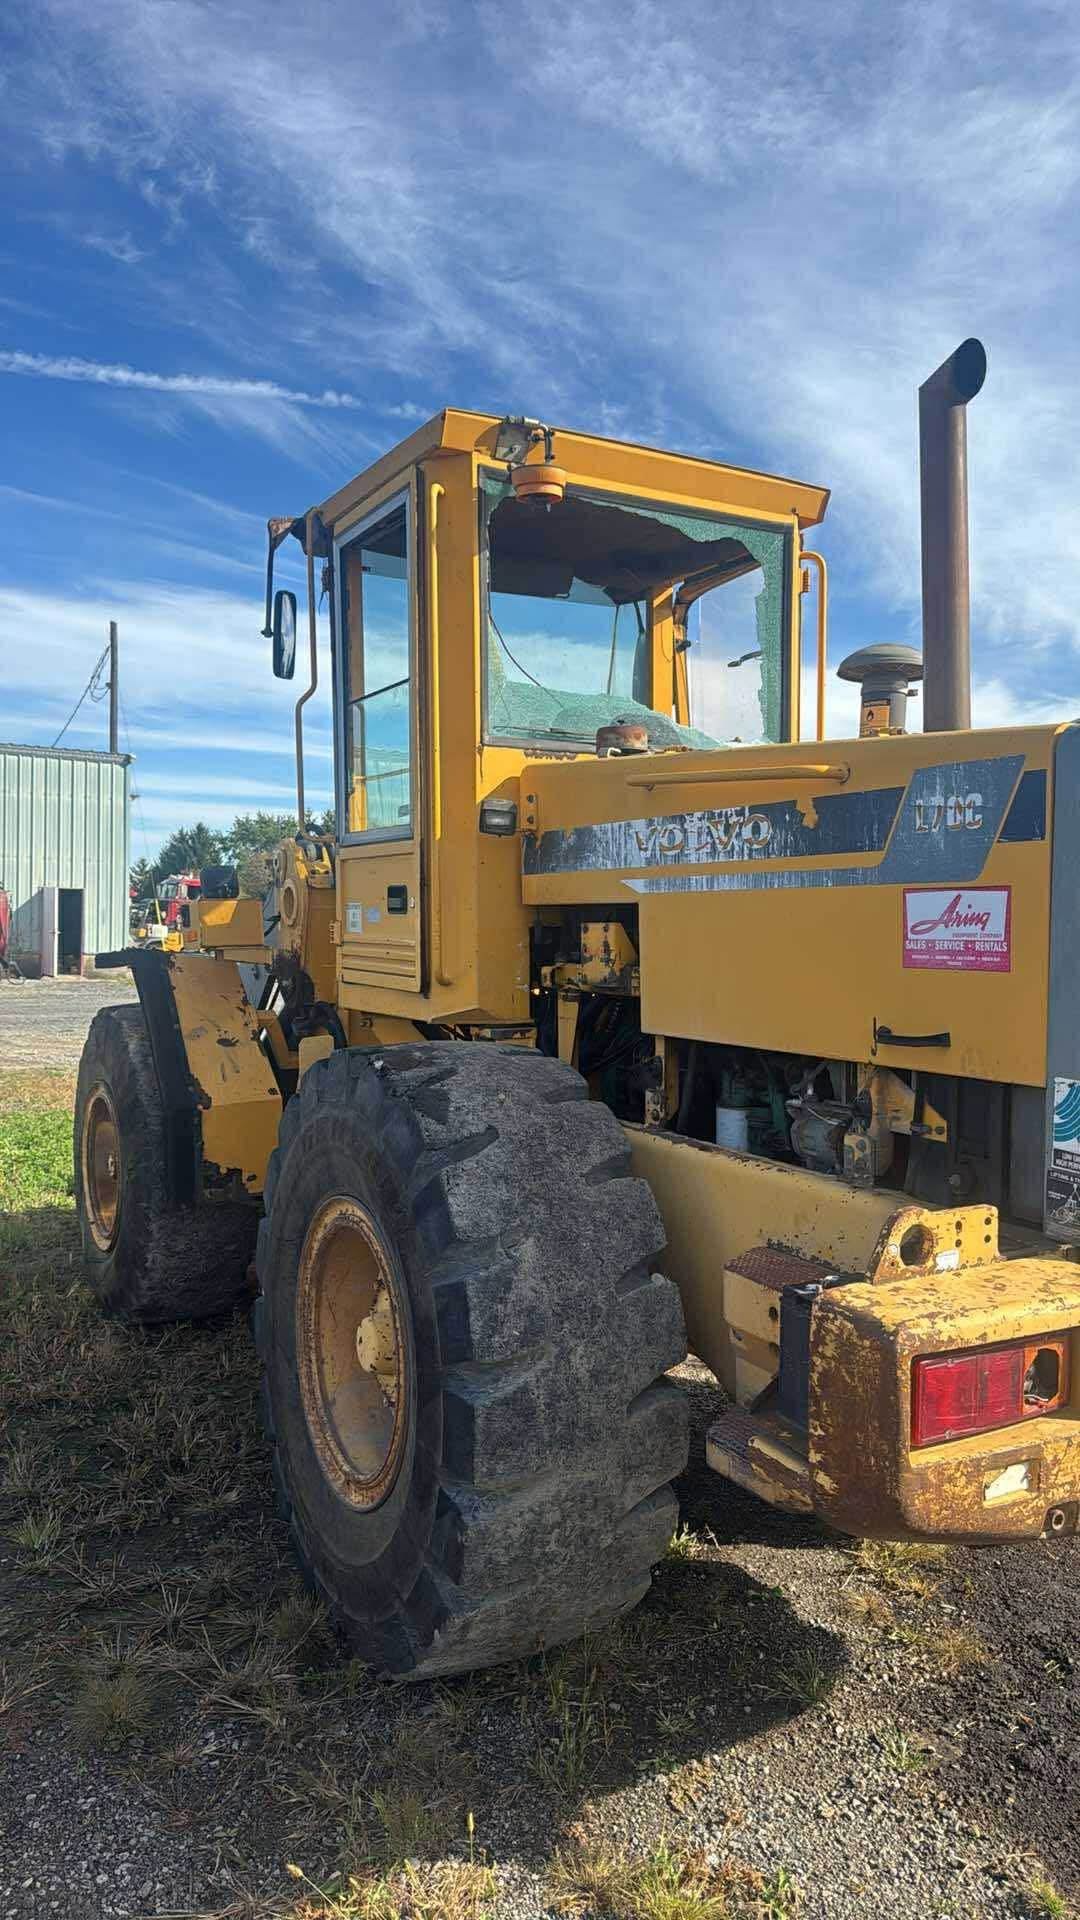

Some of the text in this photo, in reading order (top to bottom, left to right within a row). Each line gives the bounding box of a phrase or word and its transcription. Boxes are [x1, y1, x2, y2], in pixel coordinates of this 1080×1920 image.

[630, 813, 773, 856] VOLVO
[910, 894, 991, 935] Aring
[905, 941, 1008, 952] SALES SERVICE RENTALS
